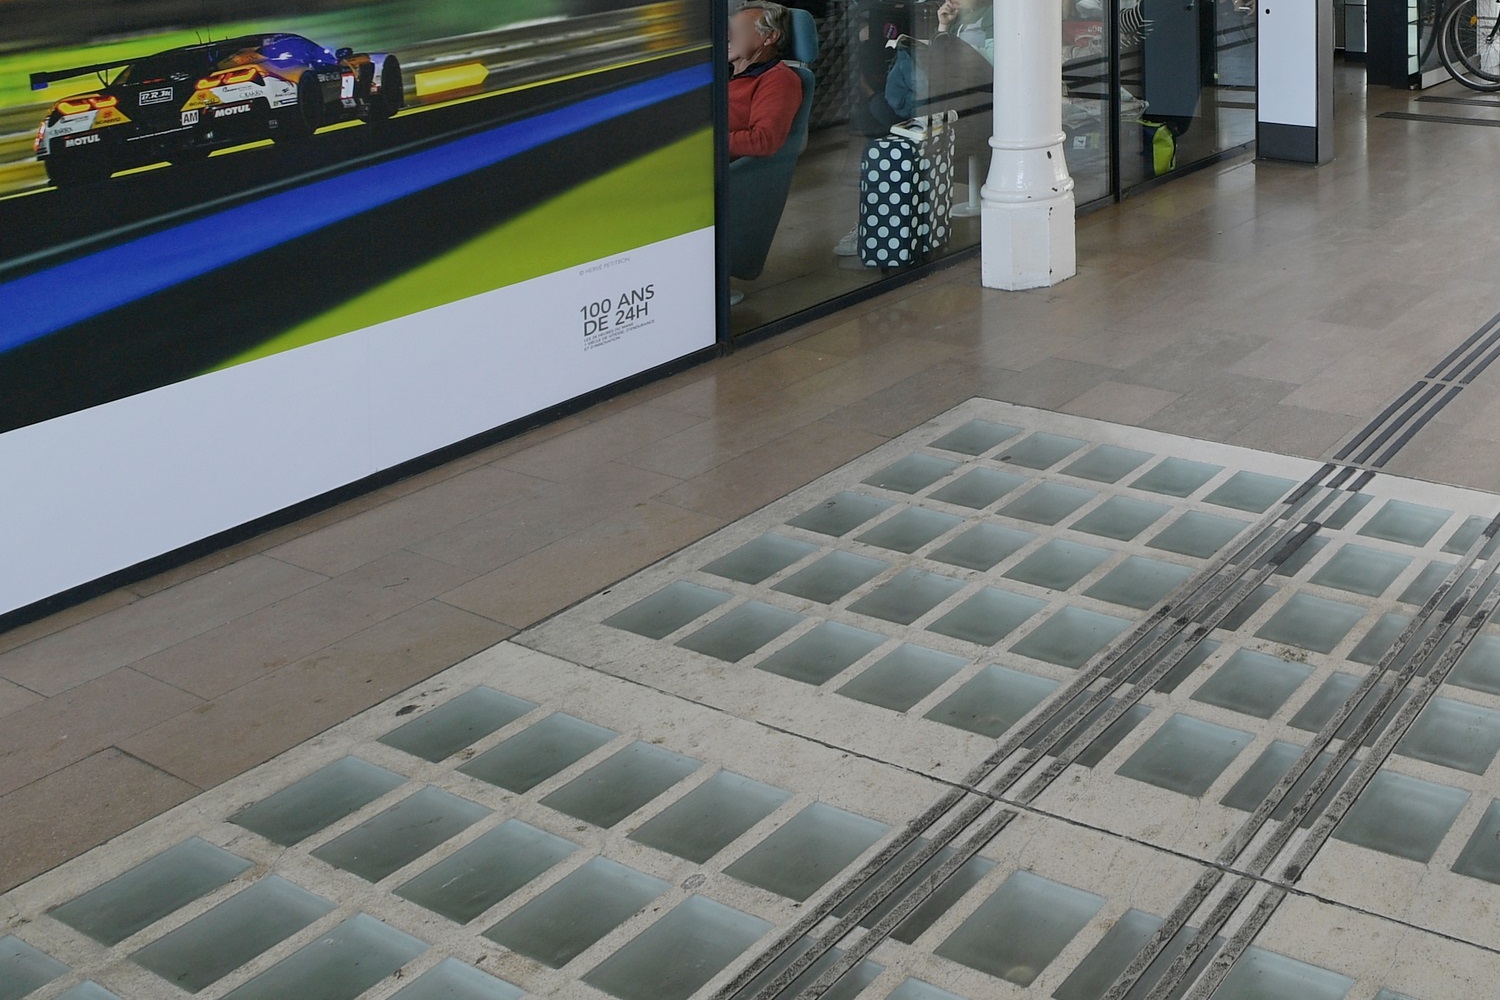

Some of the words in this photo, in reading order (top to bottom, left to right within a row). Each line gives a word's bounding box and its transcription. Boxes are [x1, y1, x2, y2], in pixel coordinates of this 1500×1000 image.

[183, 111, 199, 124] AM
[214, 104, 251, 118] MOTUL
[65, 134, 100, 148] MOTUL
[580, 298, 611, 320] 100
[617, 284, 655, 310] ANS
[584, 315, 609, 337] DE
[615, 301, 648, 326] 24H
